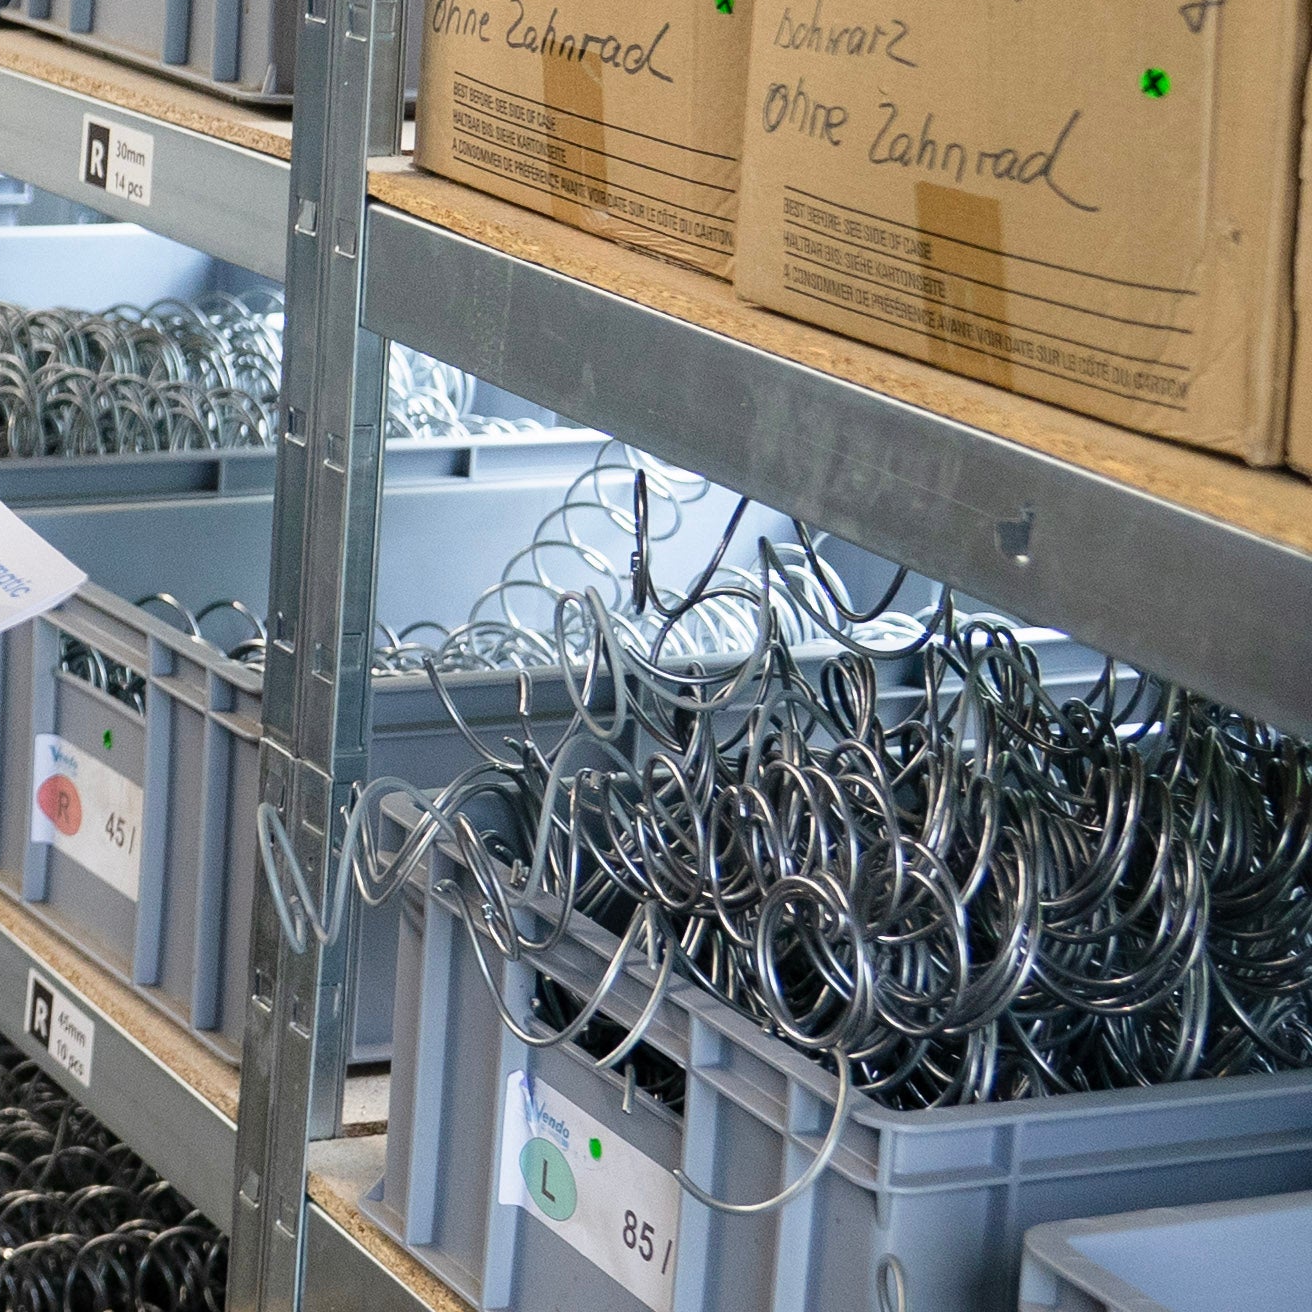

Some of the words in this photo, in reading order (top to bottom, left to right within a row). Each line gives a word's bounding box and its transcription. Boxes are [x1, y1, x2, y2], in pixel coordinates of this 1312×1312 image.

[90, 139, 105, 179] R
[115, 139, 146, 167] 30mm
[762, 76, 849, 146] ohne
[868, 100, 1100, 213] Zahnrad
[115, 171, 125, 190] 14
[126, 180, 143, 201] pcs
[57, 790, 71, 824] R
[105, 811, 126, 848] 45
[33, 996, 49, 1040] R
[57, 1038, 68, 1062] 10
[541, 1158, 556, 1203] L
[622, 1209, 656, 1263] 85
